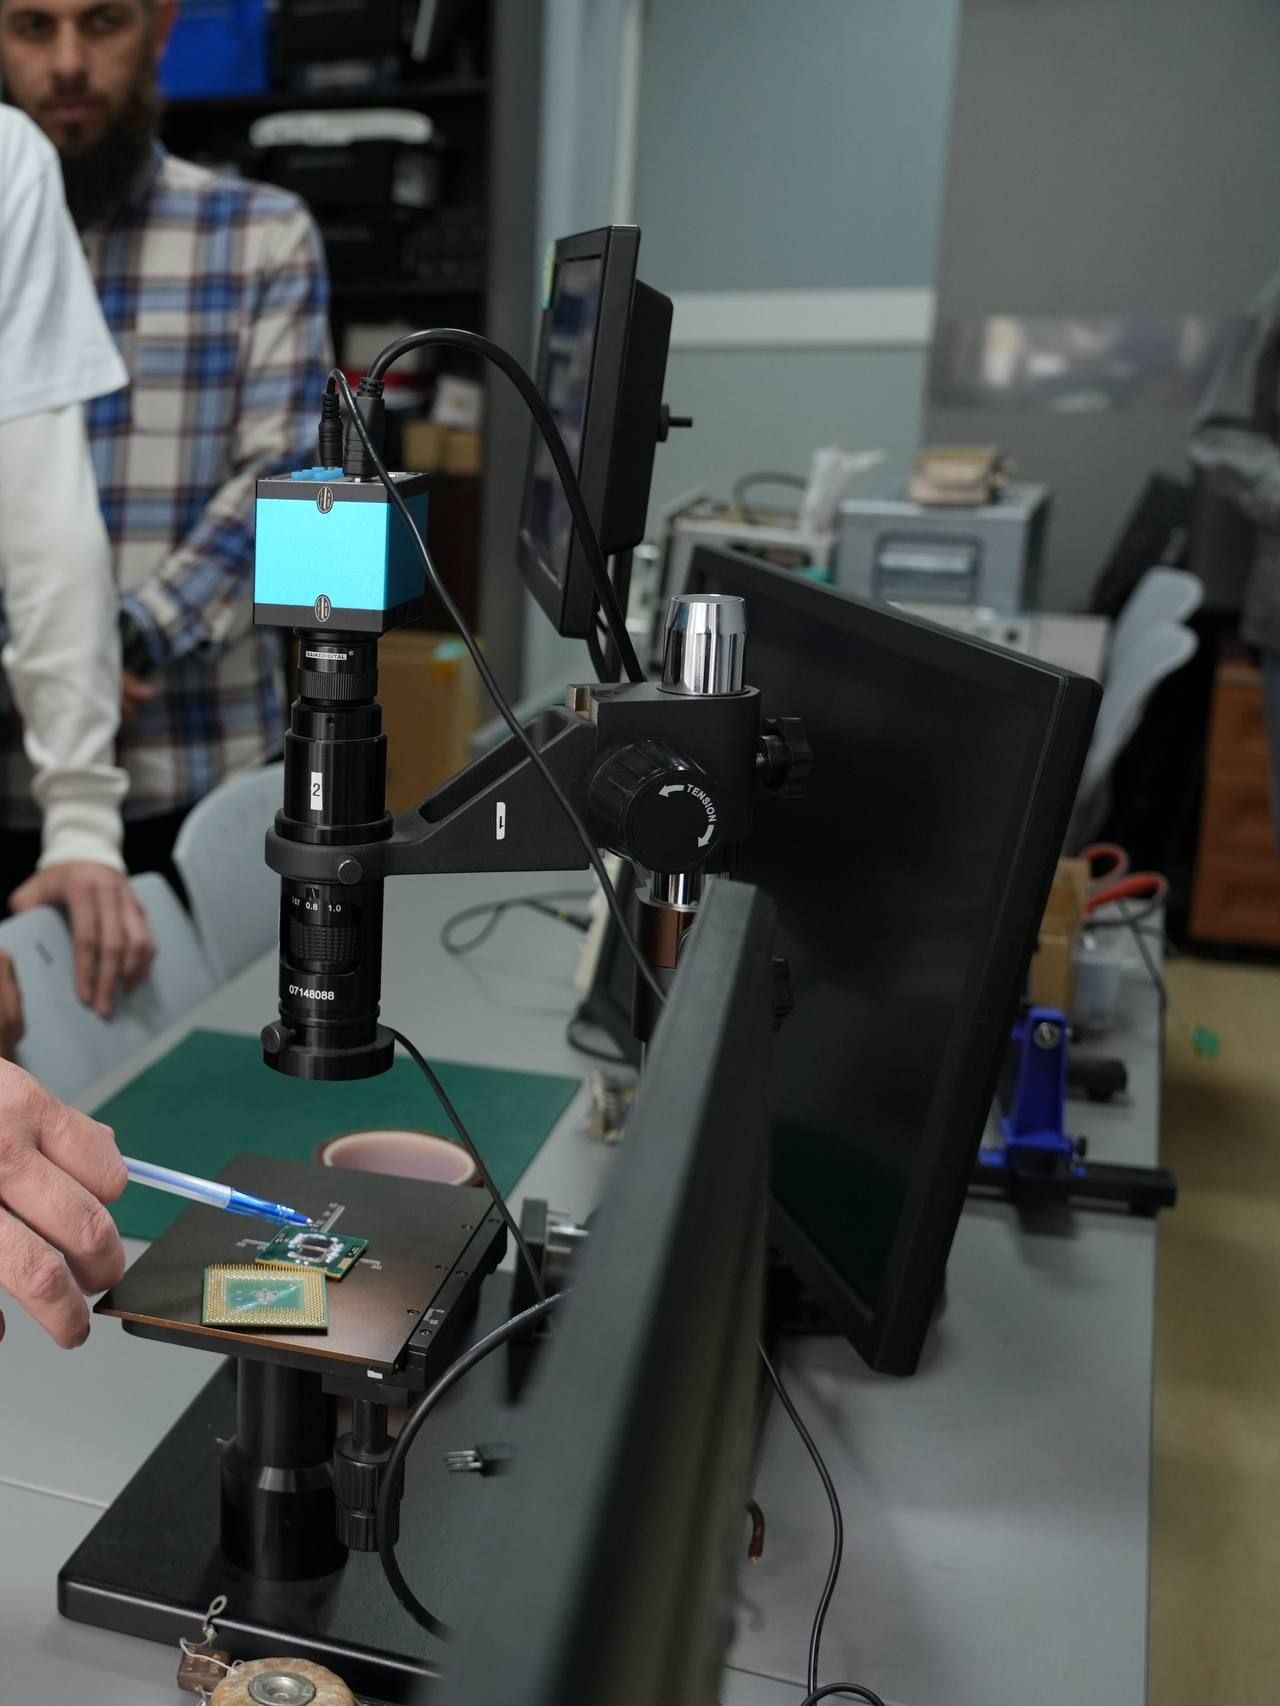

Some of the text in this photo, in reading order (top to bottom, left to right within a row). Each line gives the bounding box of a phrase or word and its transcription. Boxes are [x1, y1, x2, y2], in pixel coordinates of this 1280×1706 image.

[312, 782, 321, 797] 2
[687, 784, 717, 822] TENSION
[305, 901, 318, 911] 0.8
[328, 904, 342, 912] 1.0
[289, 984, 335, 1001] 07148088
